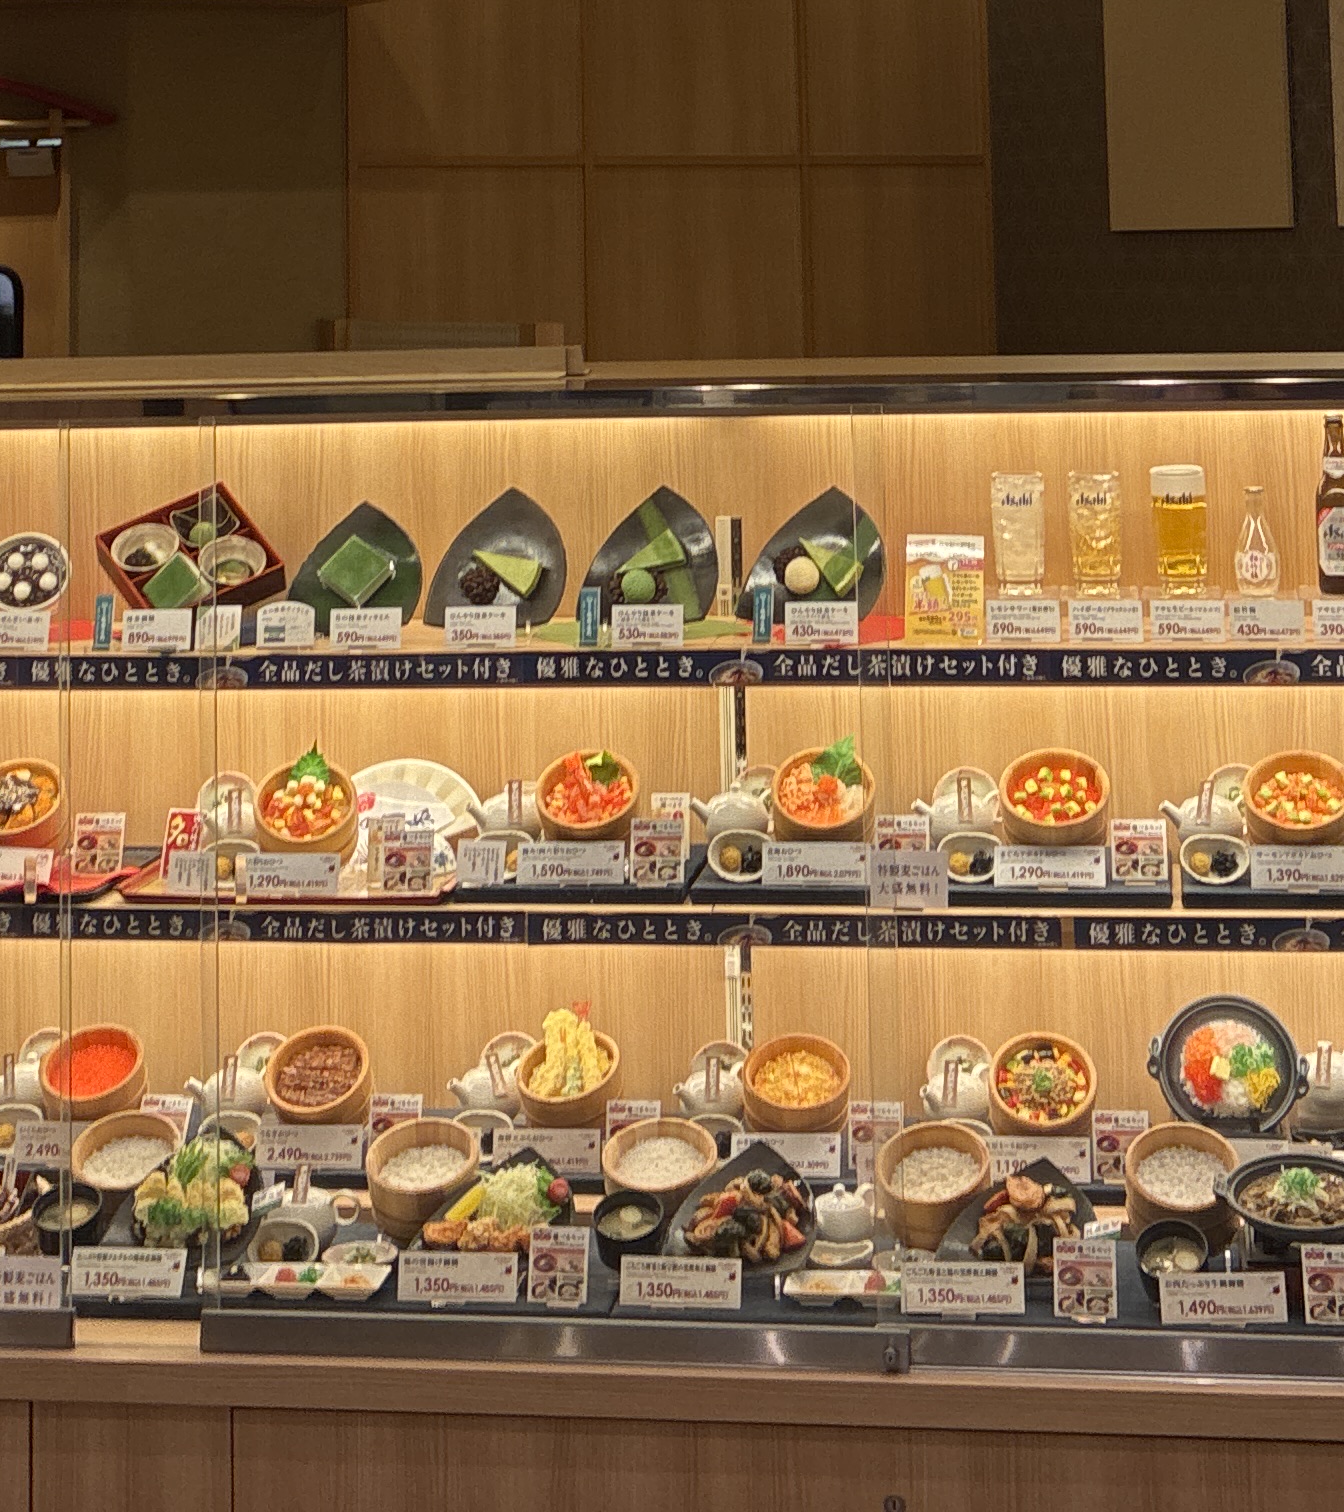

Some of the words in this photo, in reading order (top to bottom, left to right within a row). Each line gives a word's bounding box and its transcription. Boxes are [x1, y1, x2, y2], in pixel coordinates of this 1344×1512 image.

[1001, 491, 1034, 507] Asahi
[1074, 491, 1107, 507] Asahi
[1161, 491, 1193, 506] Asahi
[259, 659, 511, 683] 全品だし茶漬けセット付き
[536, 655, 705, 680] 優雅なひととき。
[773, 654, 1039, 679] 全品だし茶漬けセット付き
[1061, 655, 1238, 679] 優雅なひととき。
[877, 863, 941, 877] 特製麦ごはん
[261, 913, 516, 939] 全品だし茶漬けセット付き
[542, 916, 712, 942] 優雅なひととき。
[783, 918, 1051, 944] 全品だし茶漬けセット付き
[1088, 920, 1268, 946] 優雅なひととき。
